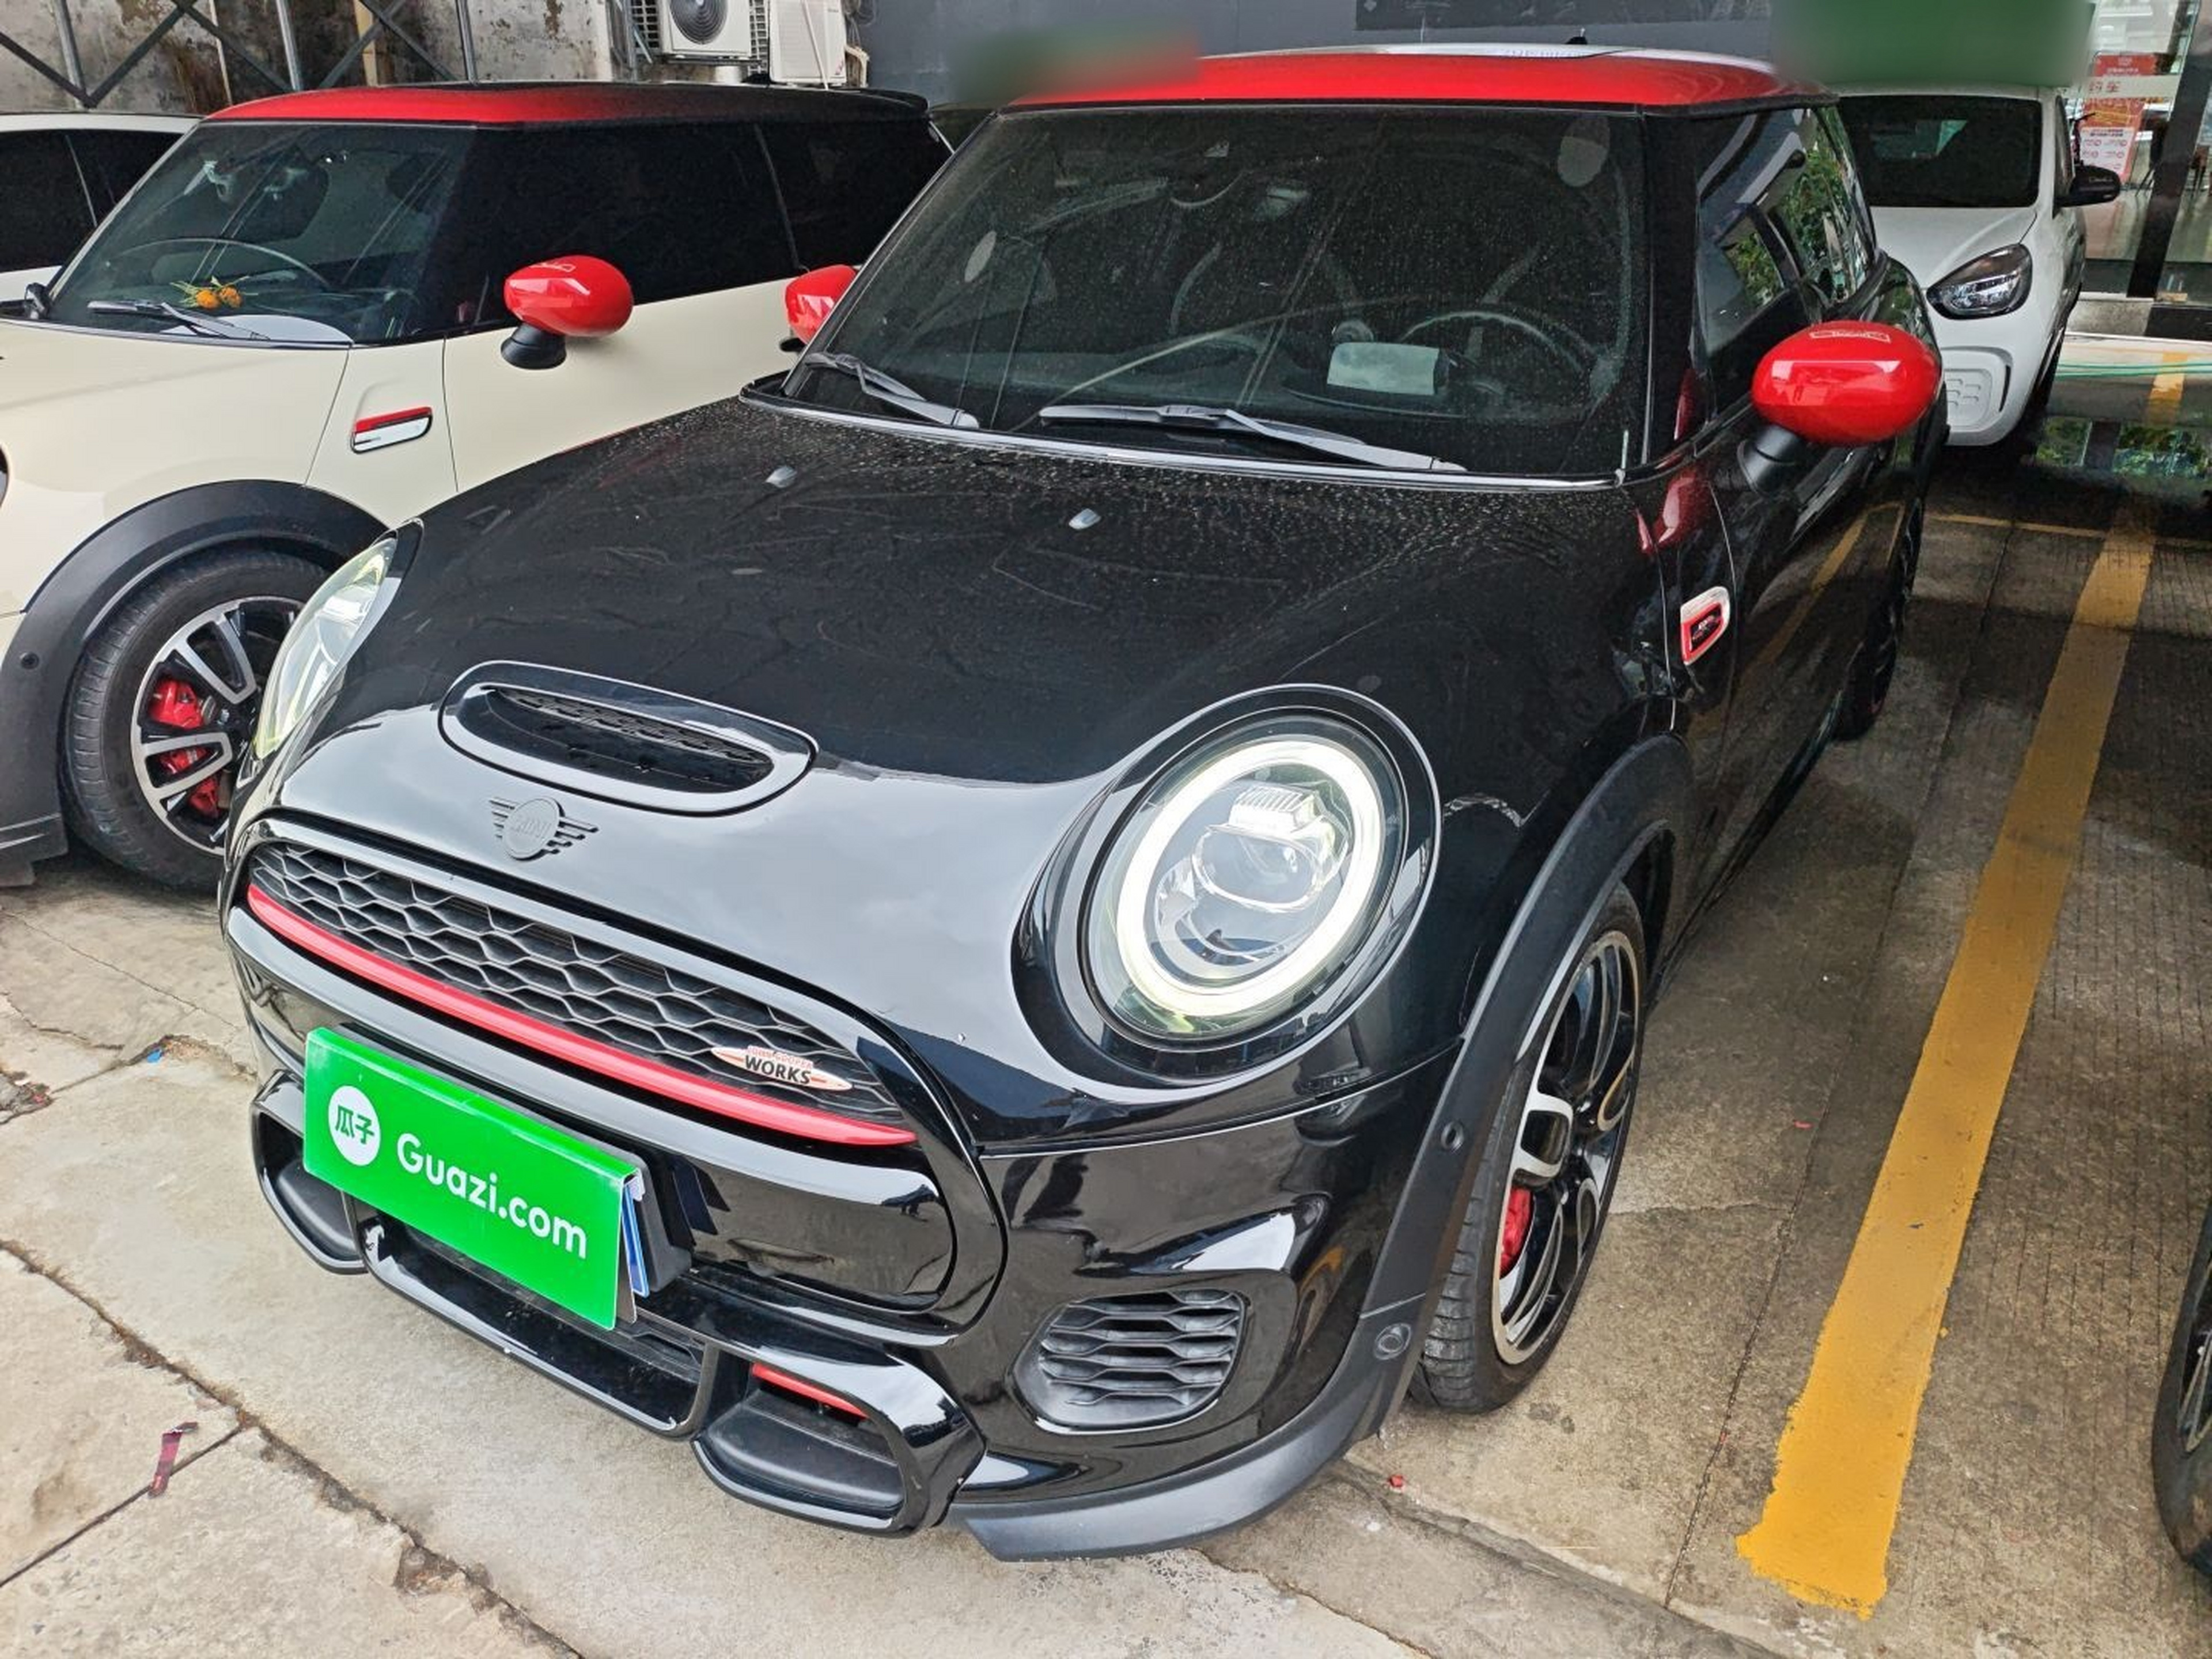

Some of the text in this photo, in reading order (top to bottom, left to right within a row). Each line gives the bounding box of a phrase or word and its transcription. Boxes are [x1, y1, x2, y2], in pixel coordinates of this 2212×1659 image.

[745, 1055, 811, 1084] WORKS
[335, 1104, 374, 1145] 瓜子
[397, 1133, 586, 1260] Guazi.com
